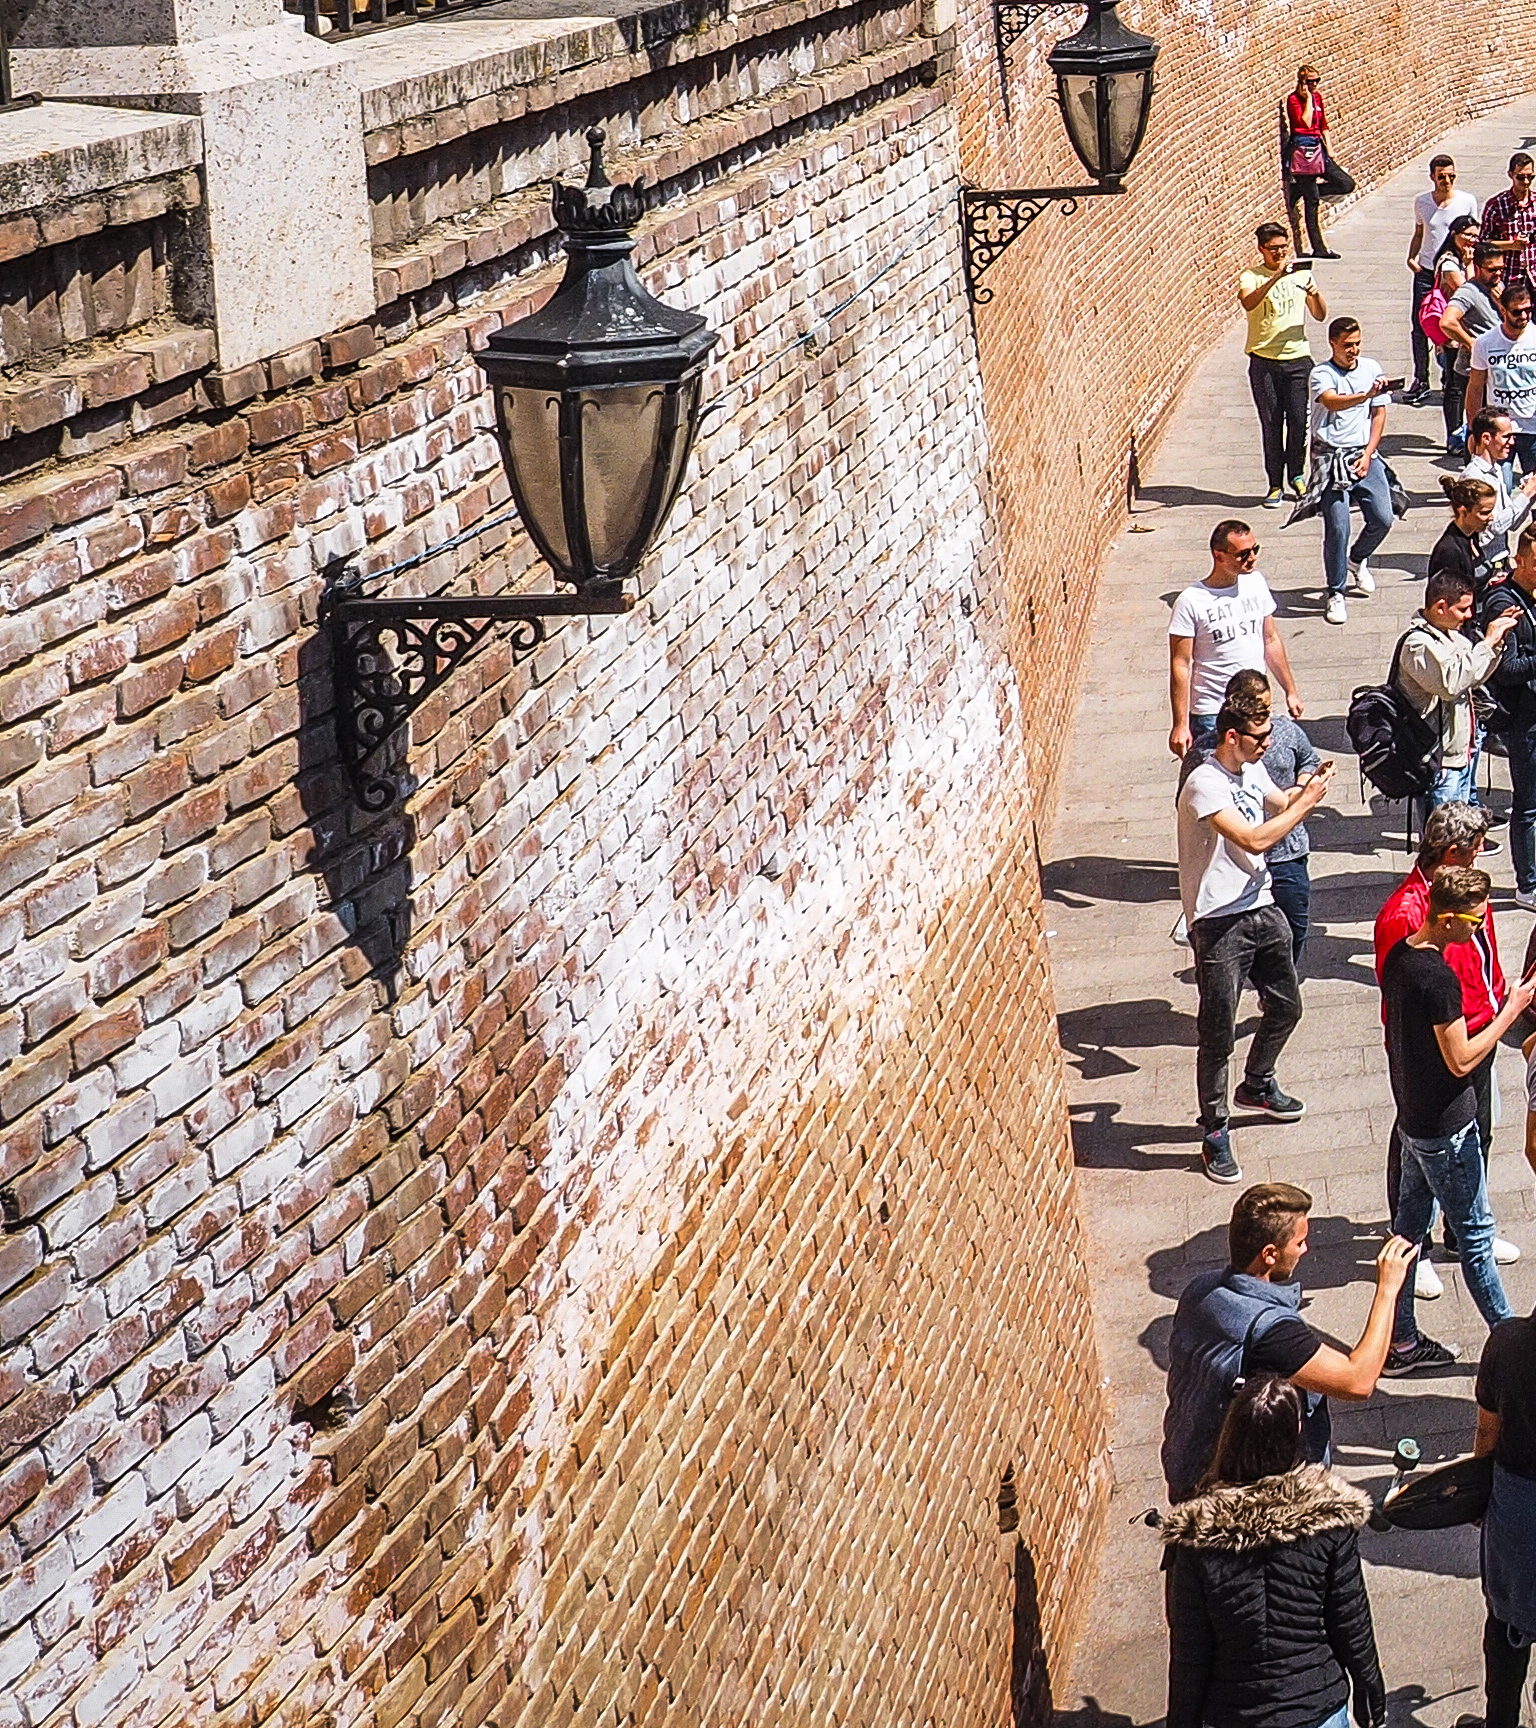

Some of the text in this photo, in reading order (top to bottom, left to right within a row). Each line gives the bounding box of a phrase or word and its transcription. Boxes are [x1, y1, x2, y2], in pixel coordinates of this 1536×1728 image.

[1206, 596, 1260, 623] EAT MY
[1211, 619, 1256, 644] DUST
